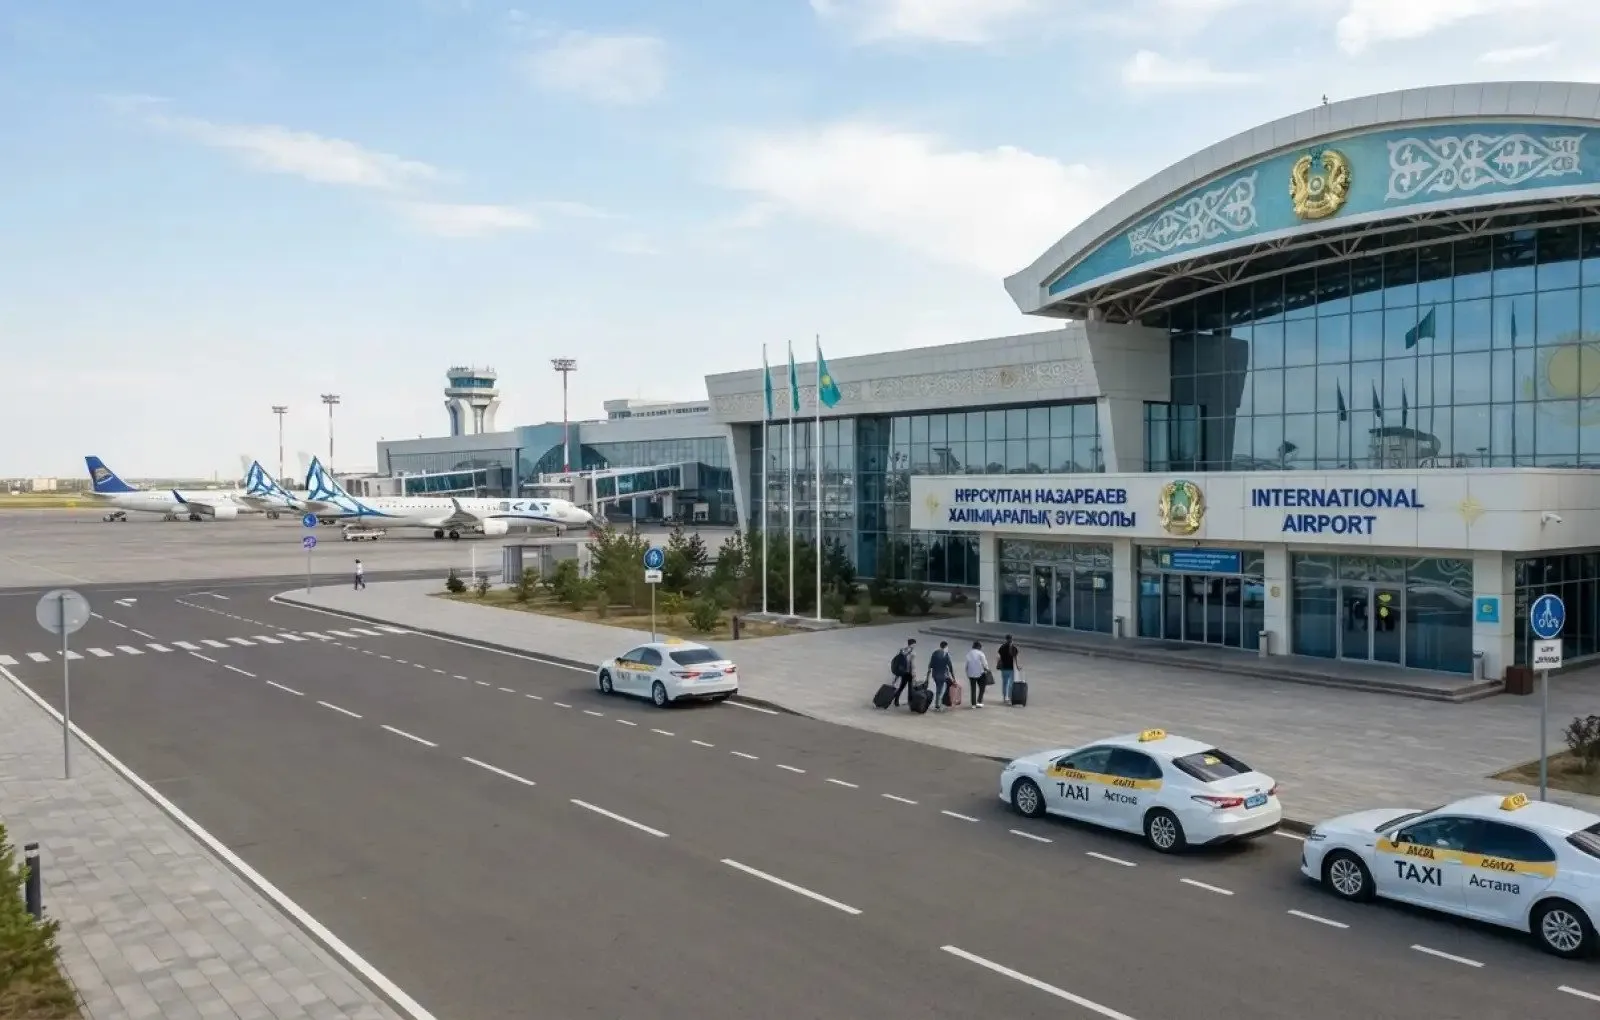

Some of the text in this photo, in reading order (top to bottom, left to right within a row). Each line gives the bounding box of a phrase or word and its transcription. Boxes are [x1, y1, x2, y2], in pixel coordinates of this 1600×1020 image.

[1035, 488, 1127, 504] НАЗАРБАЕВ
[1252, 488, 1425, 508] INTERNATIONAL
[1282, 513, 1377, 535] AIRPORT
[1056, 782, 1090, 802] TAXI
[1394, 860, 1442, 886] TAXI
